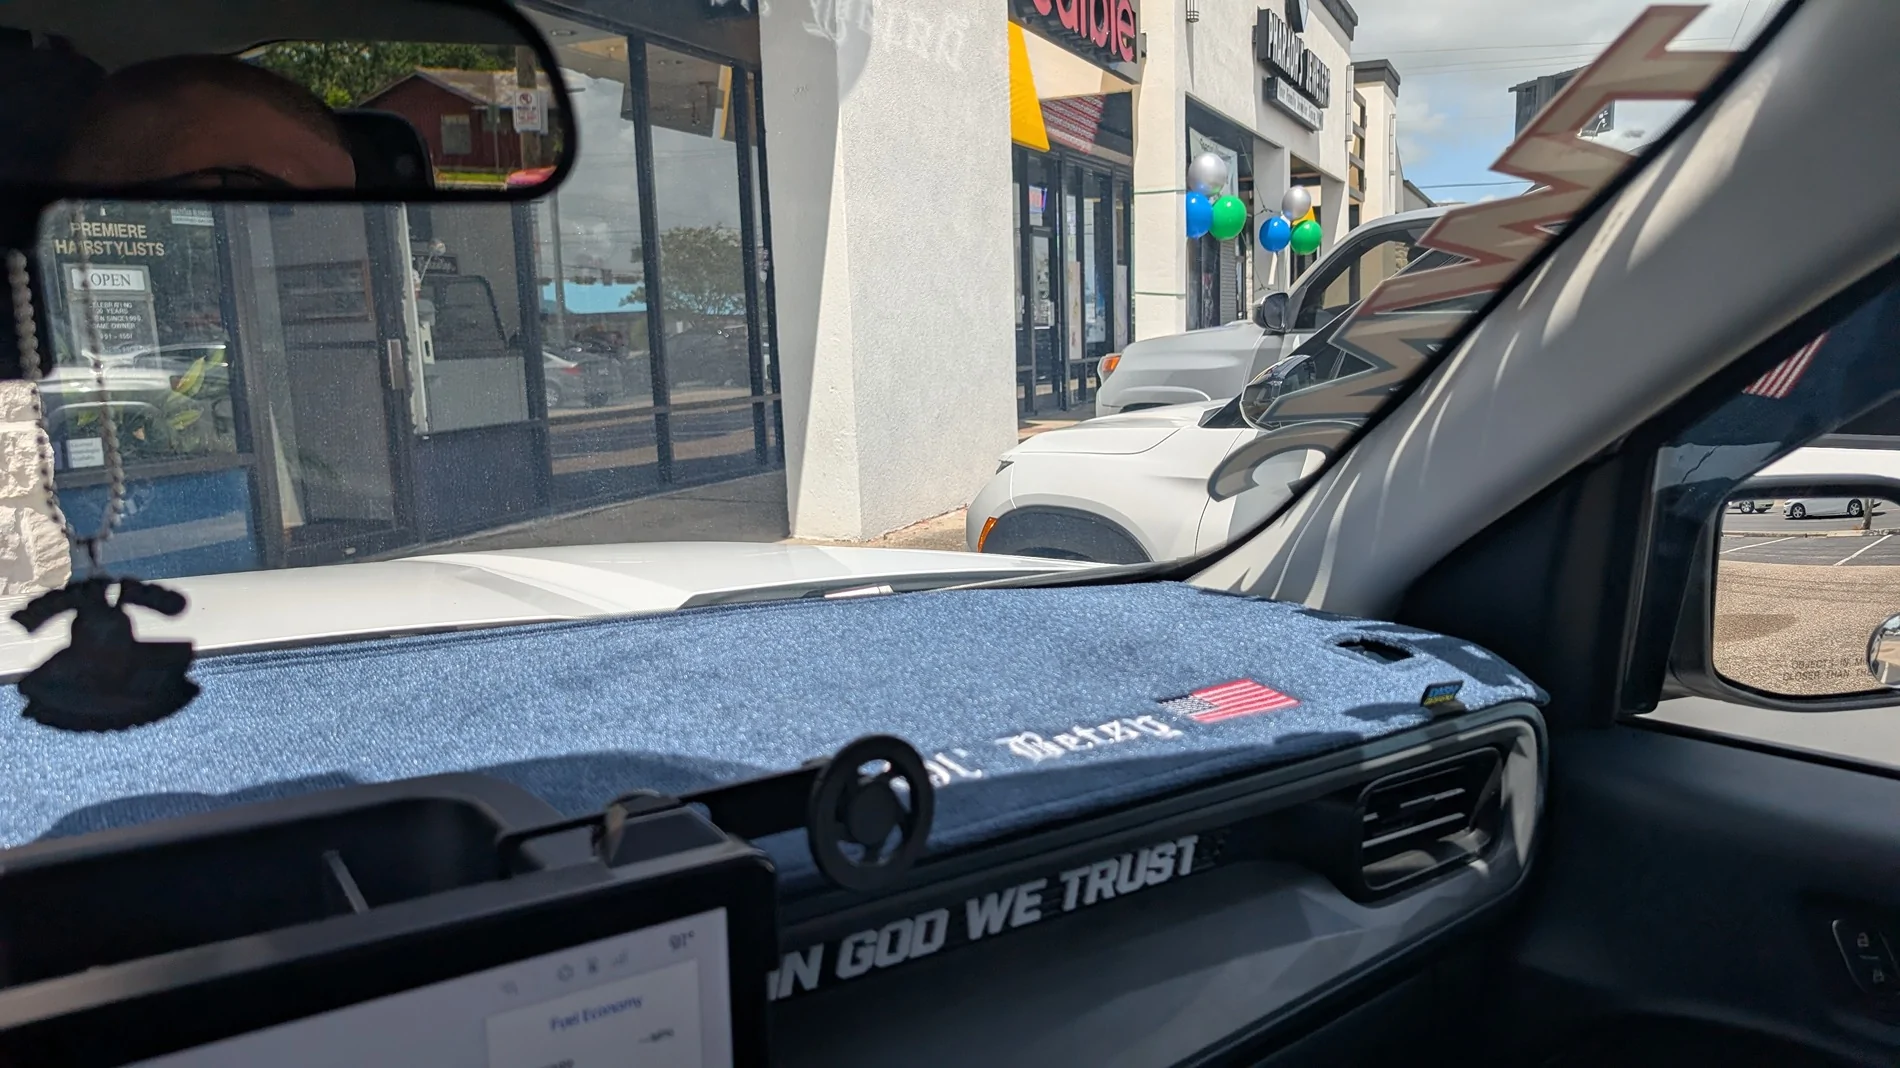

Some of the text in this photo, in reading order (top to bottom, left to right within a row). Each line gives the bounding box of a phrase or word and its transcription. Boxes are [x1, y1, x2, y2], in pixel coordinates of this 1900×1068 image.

[70, 222, 147, 239] PREMIERE
[90, 273, 131, 287] OPEN
[1783, 670, 1821, 682] CLOSER
[1827, 669, 1850, 680] THAN
[835, 907, 949, 980] GOD
[966, 878, 1048, 940] WE
[1060, 834, 1199, 912] TRUST
[549, 995, 643, 1032] Fuel Economy
